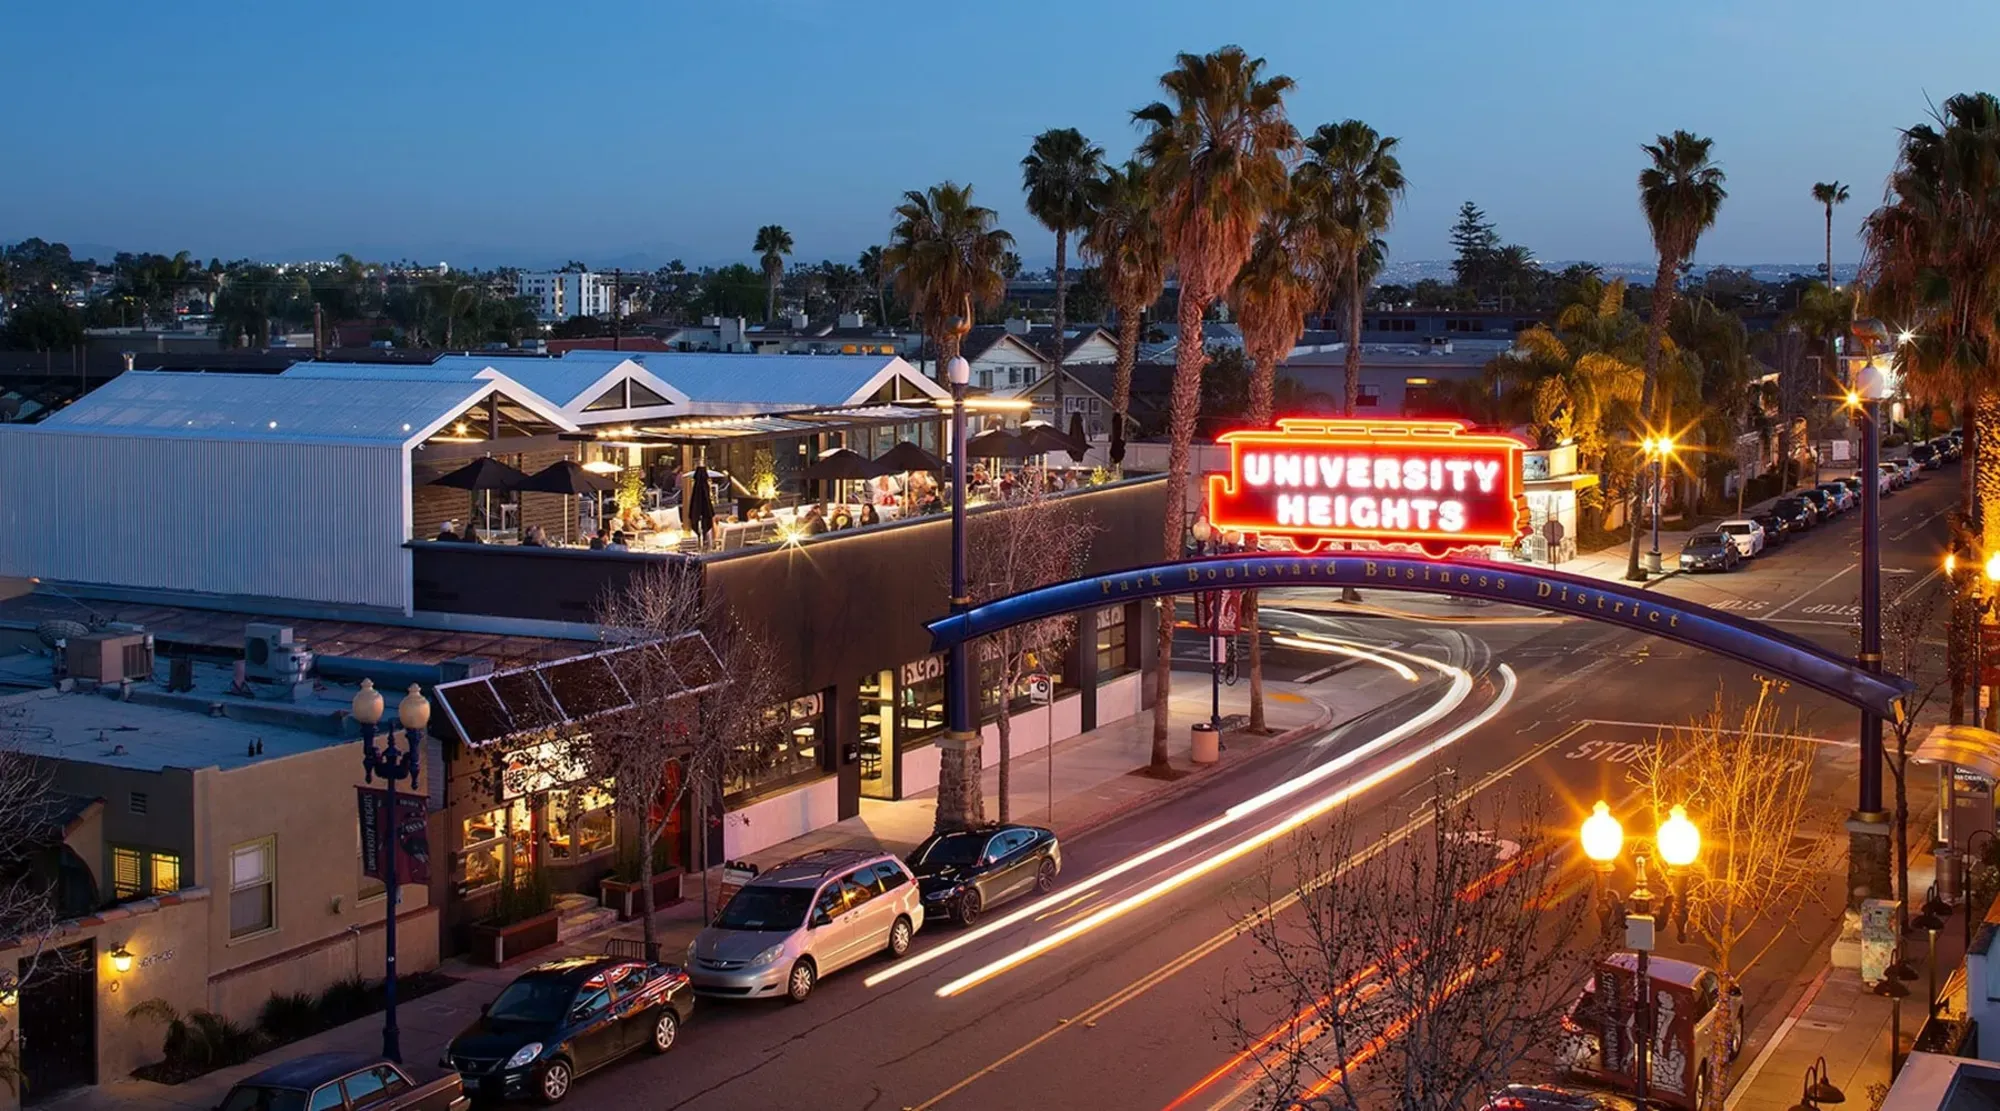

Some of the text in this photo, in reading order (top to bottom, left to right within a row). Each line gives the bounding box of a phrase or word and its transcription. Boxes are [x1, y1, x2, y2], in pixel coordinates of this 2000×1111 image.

[1243, 454, 1499, 492] UNIVERSITY
[1276, 494, 1465, 531] HEIGHTS
[1102, 560, 1680, 627] Park Boulevard Business District
[1802, 603, 1862, 616] STOP
[1565, 740, 1658, 764] STOP
